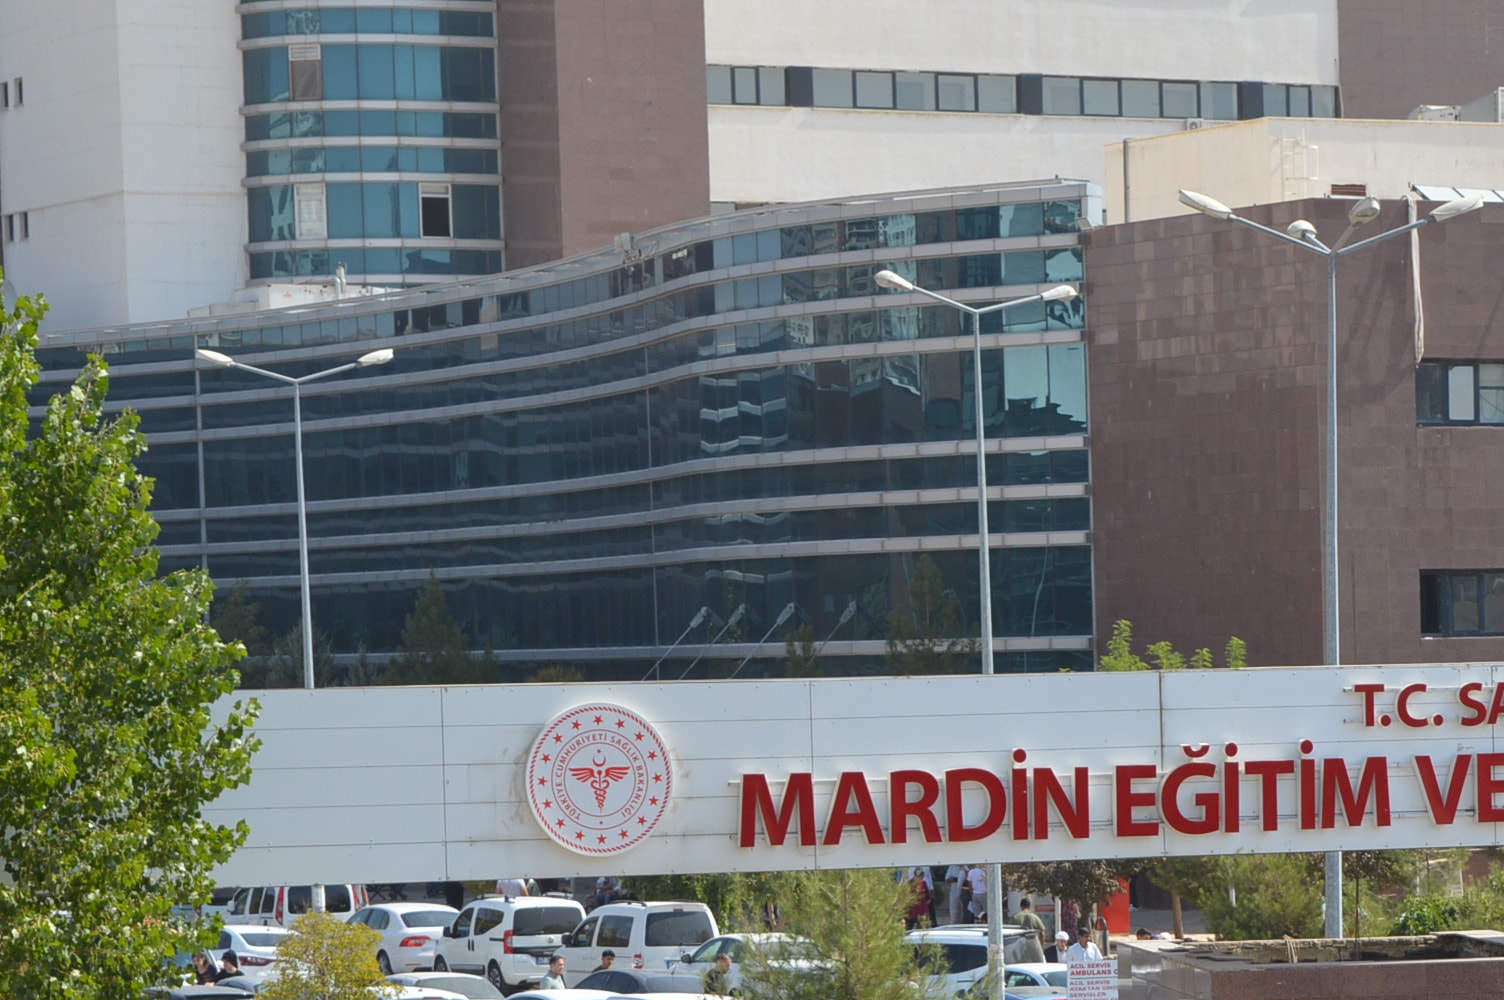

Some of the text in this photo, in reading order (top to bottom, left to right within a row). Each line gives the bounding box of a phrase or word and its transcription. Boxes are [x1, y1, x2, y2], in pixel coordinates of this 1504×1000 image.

[1353, 682, 1444, 728] T.C.
[555, 732, 646, 821] TÜRKİYE CUMHURİYETİ SAĞLIK BAKANLIĞI
[740, 747, 1090, 848] MARDİN
[1115, 739, 1391, 838] EĞİTİM
